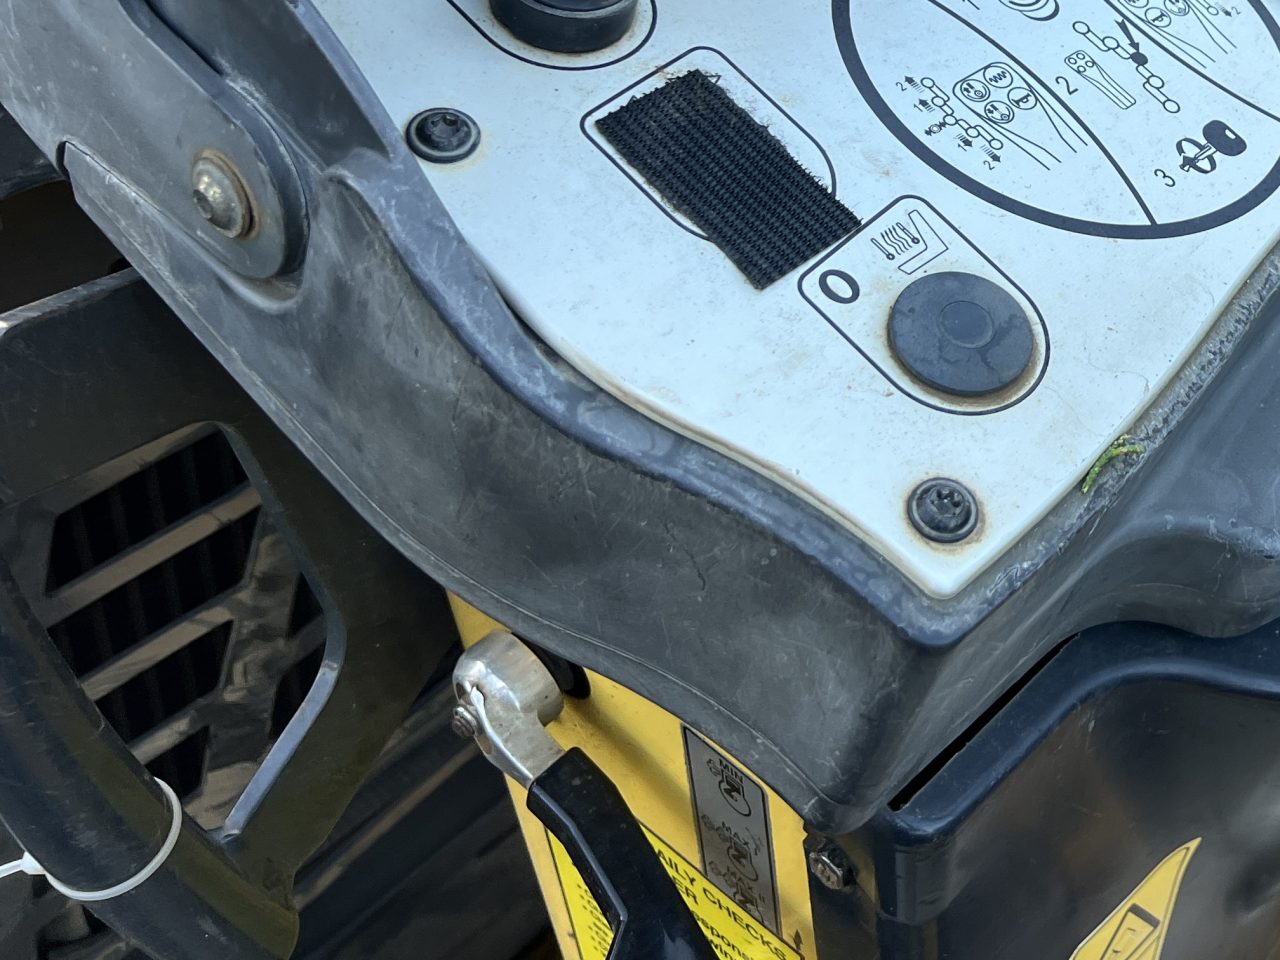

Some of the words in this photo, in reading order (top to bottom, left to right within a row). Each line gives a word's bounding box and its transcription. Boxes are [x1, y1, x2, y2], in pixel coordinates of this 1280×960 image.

[895, 81, 908, 92] 2
[1055, 75, 1079, 96] 2
[983, 159, 996, 171] 2
[1153, 168, 1176, 188] 3
[718, 757, 744, 786] MIN
[657, 848, 697, 886] AILY
[702, 886, 787, 960] CHECKS
